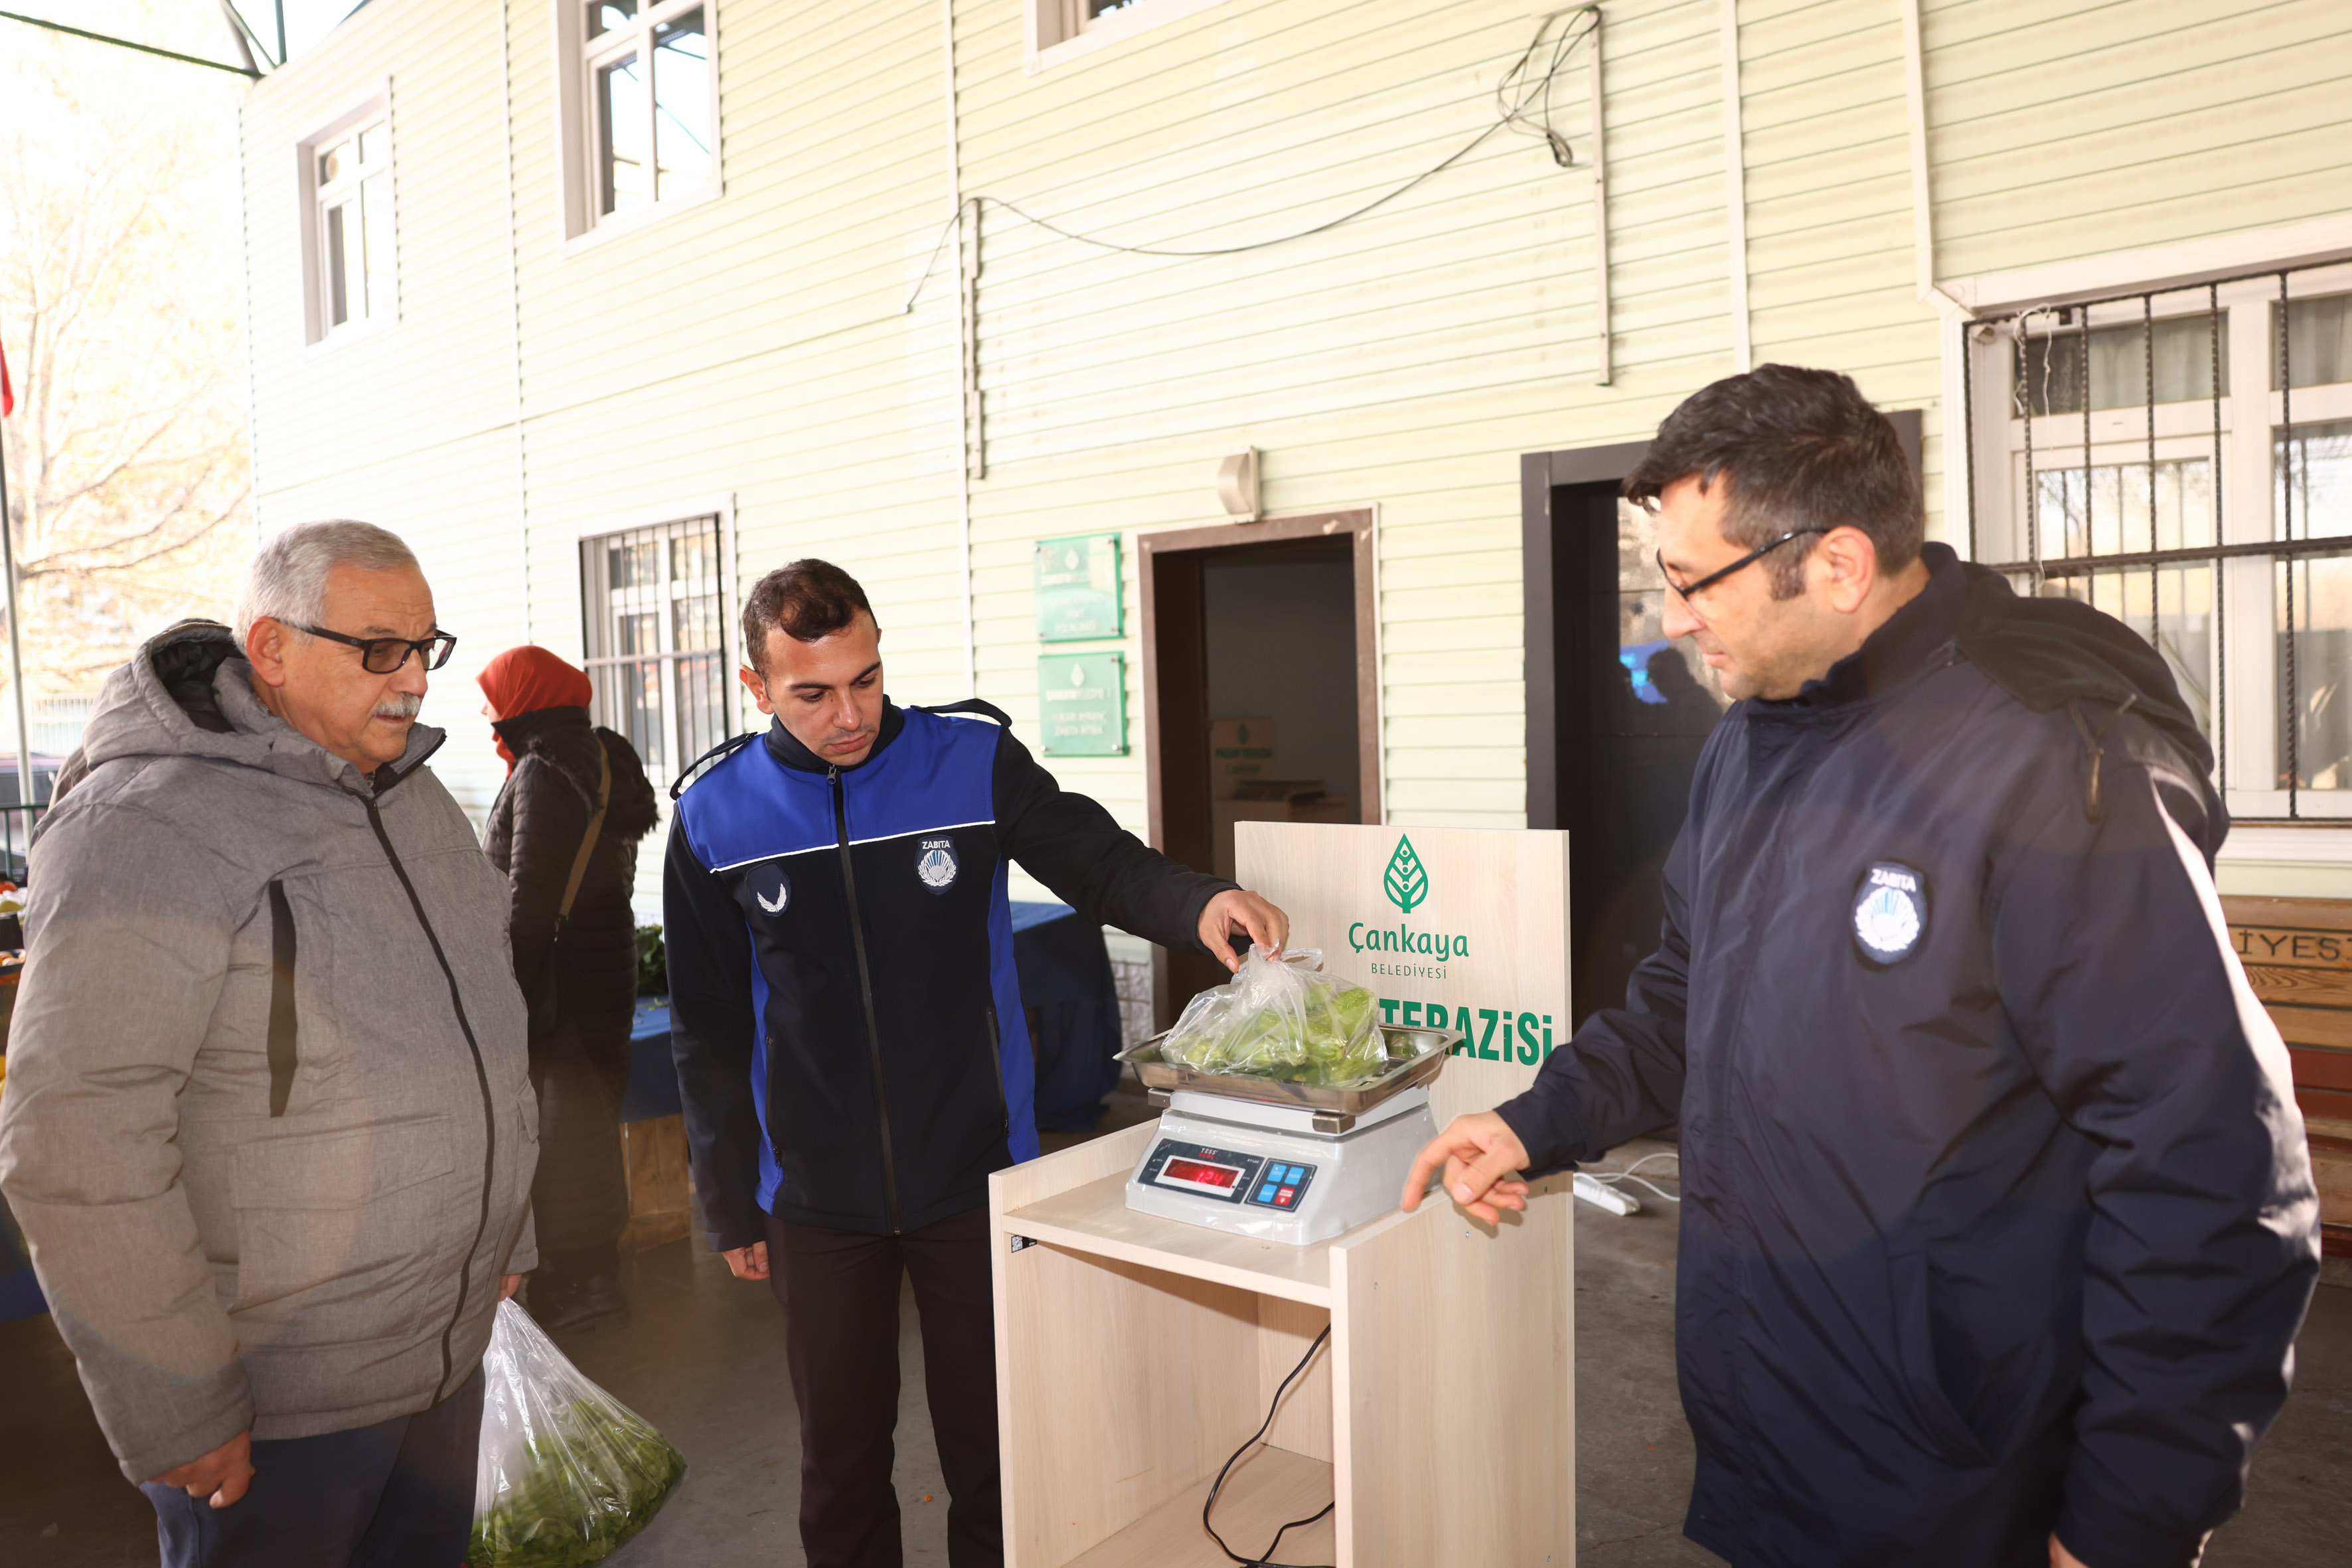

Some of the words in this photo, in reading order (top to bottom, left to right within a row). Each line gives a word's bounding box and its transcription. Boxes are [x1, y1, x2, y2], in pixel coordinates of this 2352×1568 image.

[921, 840, 951, 850] ZABITA
[1869, 868, 1917, 893] ZABITA
[1348, 922, 1469, 962] Çankaya
[1371, 963, 1447, 979] BELEDİYESİ
